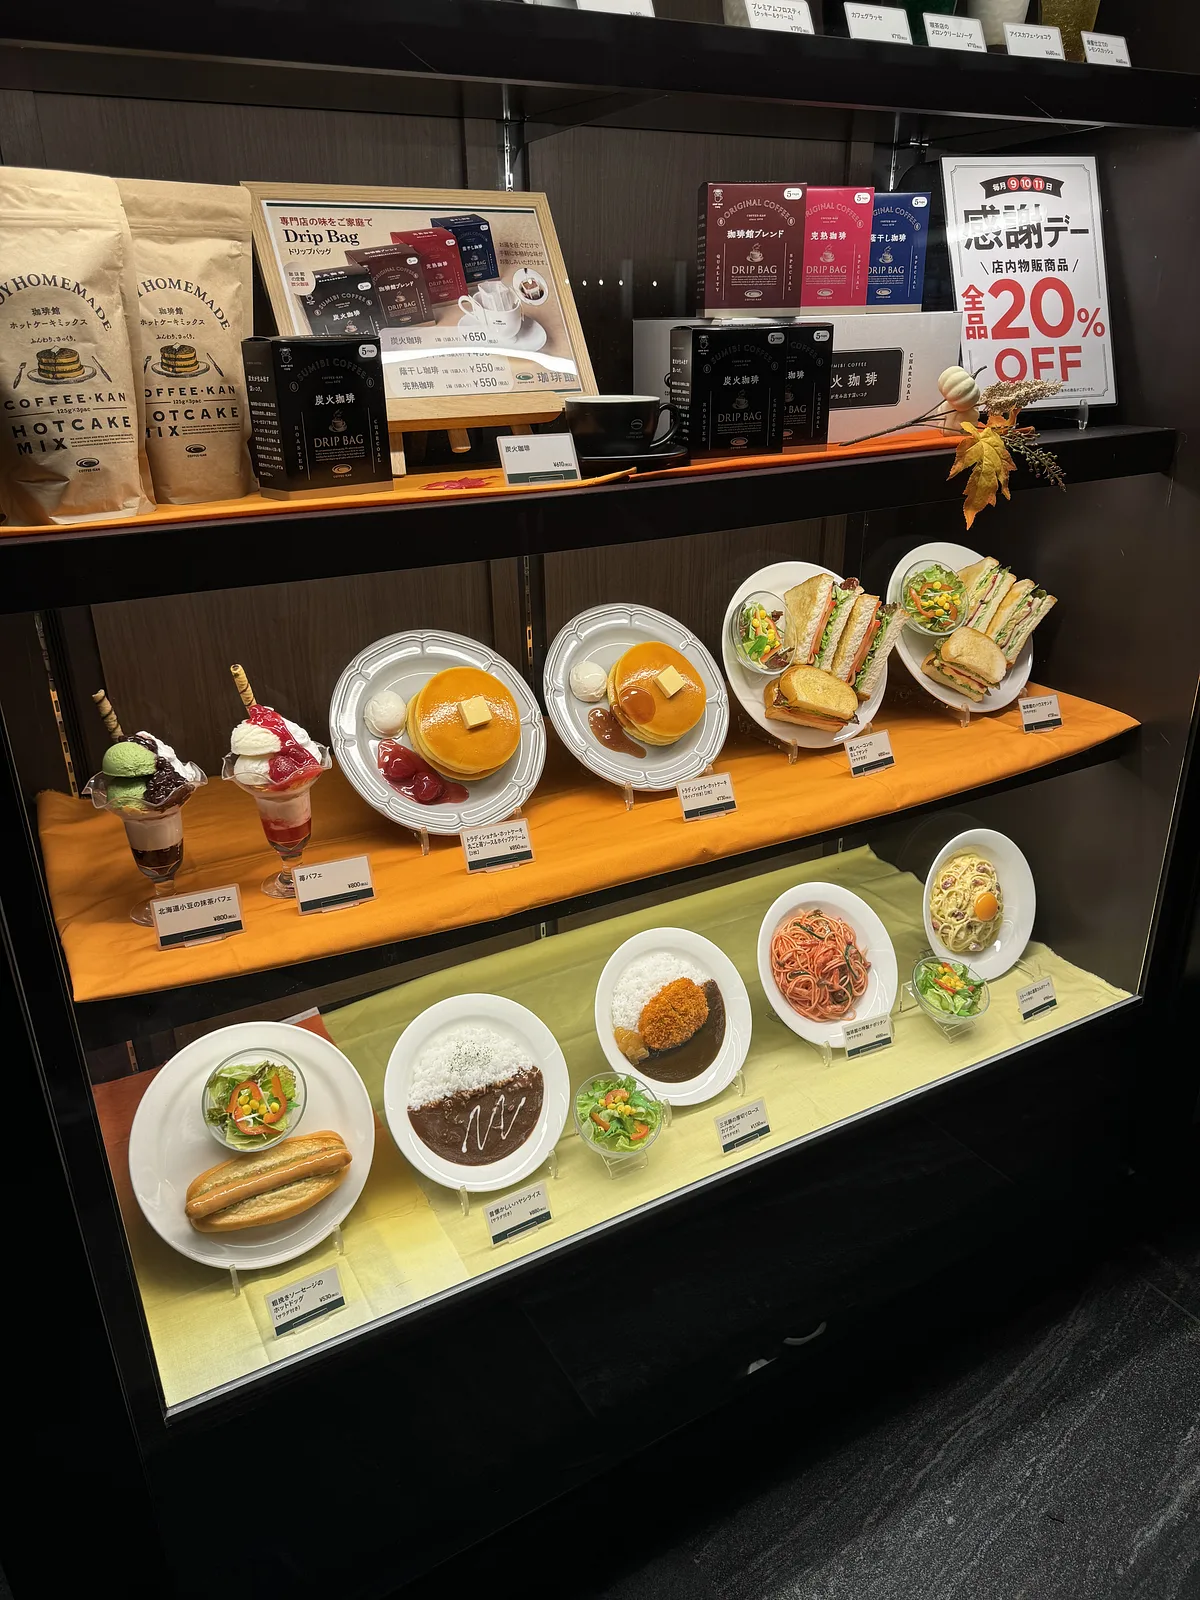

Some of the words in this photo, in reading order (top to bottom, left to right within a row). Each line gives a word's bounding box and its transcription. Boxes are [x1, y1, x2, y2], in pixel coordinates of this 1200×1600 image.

[851, 12, 883, 21] カフェグラッセ
[992, 182, 1007, 192] 毎月
[1010, 179, 1017, 188] 9
[1021, 178, 1032, 188] 10
[1034, 179, 1043, 189] 11
[1046, 182, 1053, 191] 日
[723, 199, 762, 219] ORIGINAL
[763, 200, 790, 220] COFFEE
[805, 202, 834, 219] RIGINAL
[836, 203, 859, 223] COFFEE
[872, 206, 894, 217] GINAL
[894, 207, 917, 225] COFFEE
[279, 216, 373, 228] 専門店の味をご家庭で
[282, 228, 323, 246] Drip
[326, 229, 360, 246] Bag
[727, 229, 784, 239] 珈琲館ブレンド
[810, 231, 847, 241] 完熟珈琲
[288, 247, 332, 256] ドリップバッグ
[731, 265, 756, 275] DRIP
[758, 265, 777, 275] BAG
[806, 265, 828, 275] DRIP
[829, 265, 847, 274] BAG
[887, 265, 905, 275] BAG
[992, 258, 1069, 274] 店内物販商品
[10, 273, 112, 333] HOMEMADE
[141, 277, 231, 331] HOMEMADE
[387, 302, 403, 312] DRIP
[403, 300, 417, 309] BAG
[31, 306, 61, 317] 珈琲館
[158, 307, 184, 316] 珈琲館
[961, 284, 989, 341] 全品
[9, 318, 88, 330] ホットケーキミックス
[140, 318, 206, 327] ホットケーキミックス
[390, 336, 422, 345] 炭火珈琲
[462, 331, 487, 343] ¥650
[361, 347, 367, 355] 5
[711, 345, 741, 365] SUMIBI
[744, 344, 772, 363] COFFEE
[297, 359, 330, 382] SUMIBI
[332, 358, 367, 379] COFFEE
[399, 366, 439, 376] 蔭干し珈琲
[469, 363, 494, 374] ¥550
[994, 345, 1083, 384] OFF
[723, 375, 760, 386] 炭火珈琲
[786, 370, 805, 380] 珈琲
[830, 371, 878, 388] 火珈琲
[906, 352, 915, 402] CHARCOAL
[402, 381, 435, 391] 完熟珈琲
[473, 377, 498, 388] ¥550
[315, 393, 356, 406] 炭火珈琲
[152, 406, 239, 423] OTCAKE
[788, 404, 807, 414] BAG
[717, 412, 742, 423] DRIP
[743, 411, 762, 421] BAG
[12, 416, 131, 439] HOTCAKE
[16, 437, 68, 456] MIX
[313, 436, 340, 448] DRIP
[342, 434, 364, 446] BAG
[373, 418, 382, 463] CHARCOAL
[505, 445, 530, 453] 炭火珈琲
[299, 872, 323, 882] 苺パフェ
[347, 881, 360, 889] ¥800
[158, 895, 232, 915] 北海道小豆の抹茶パフェ
[213, 913, 228, 922] ¥800
[271, 1279, 324, 1308] 粗挽きソーセージの
[273, 1294, 304, 1314] ホットドッグ
